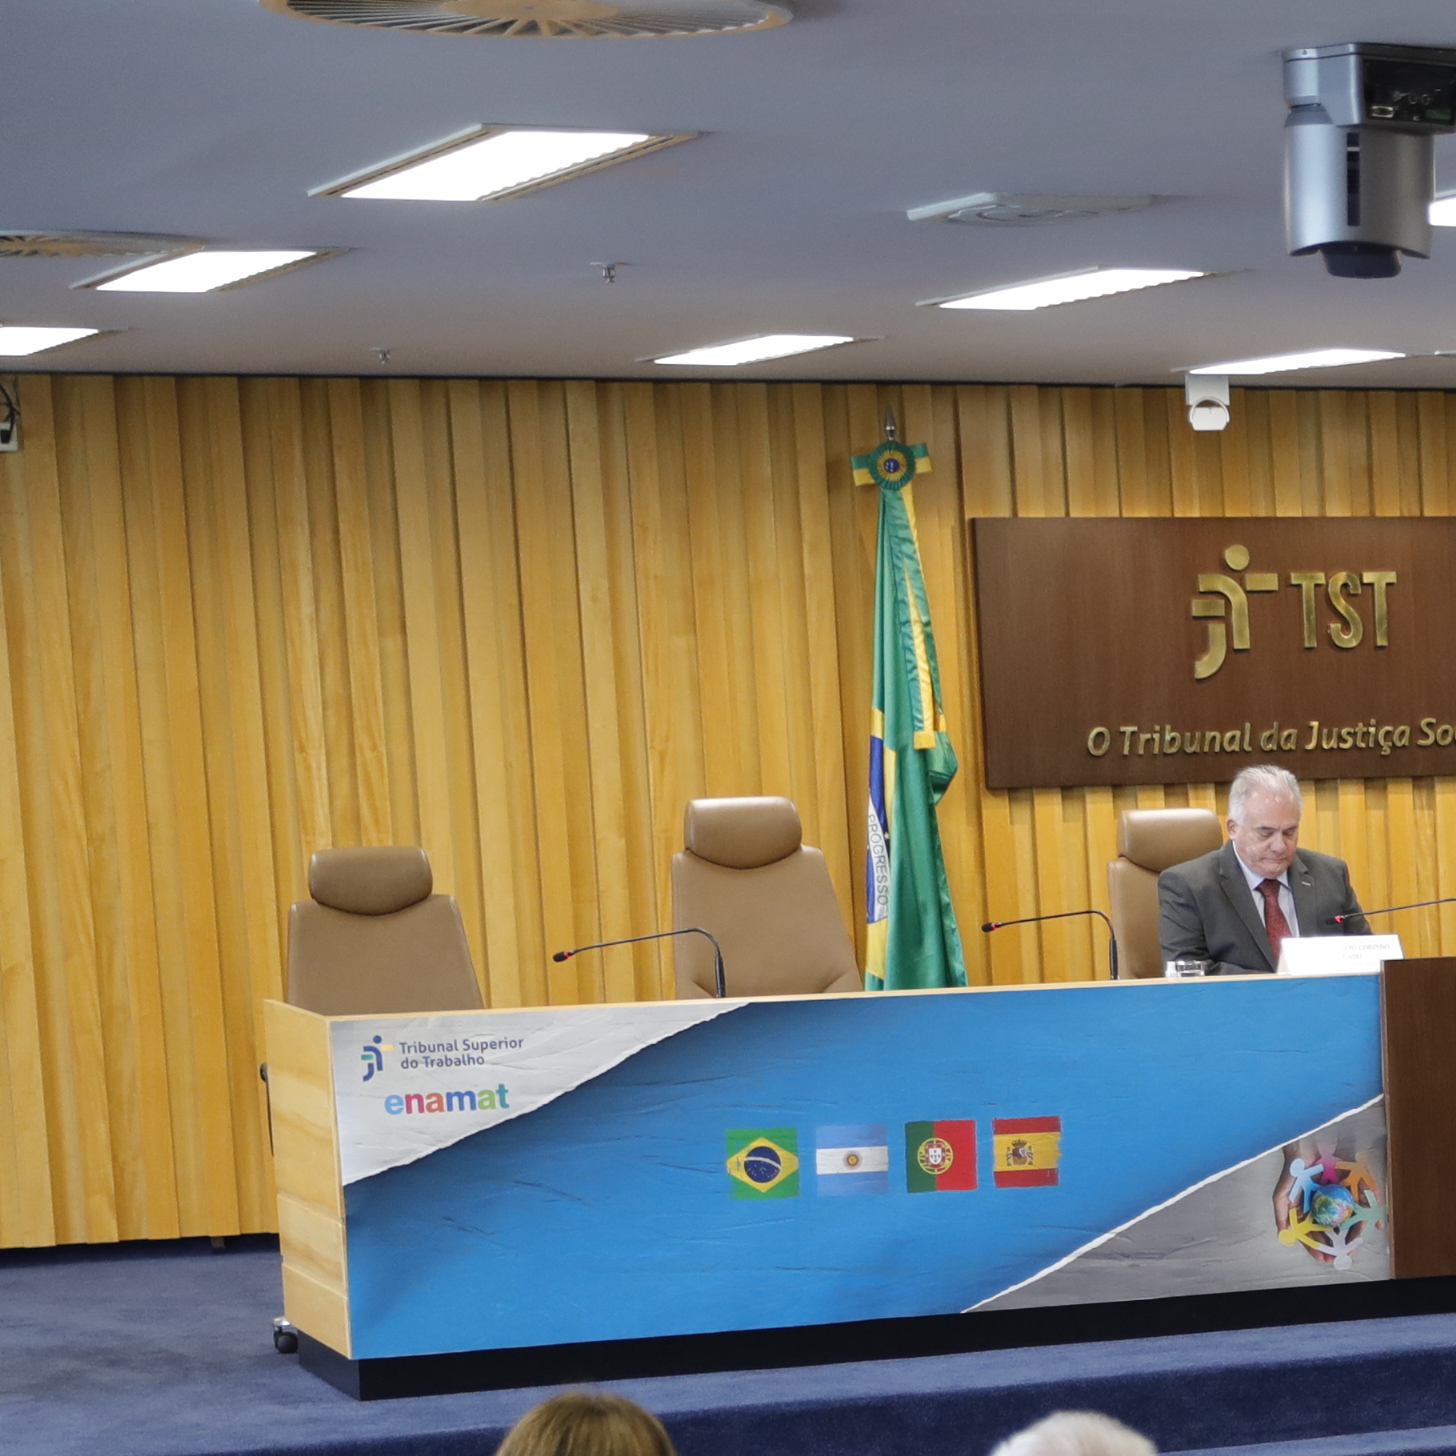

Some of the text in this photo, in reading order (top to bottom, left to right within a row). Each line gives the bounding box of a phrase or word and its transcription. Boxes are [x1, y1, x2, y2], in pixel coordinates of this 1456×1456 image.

[1290, 571, 1397, 649] TST
[1087, 726, 1111, 756] O
[1119, 722, 1252, 756] Tribunal
[1260, 721, 1298, 752] da
[1304, 719, 1410, 756] Justiça
[867, 813, 889, 906] PROGRESSO
[399, 1037, 524, 1054] Tribunal Superior
[400, 1054, 485, 1069] do Trabalho
[384, 1083, 510, 1115] enamat
